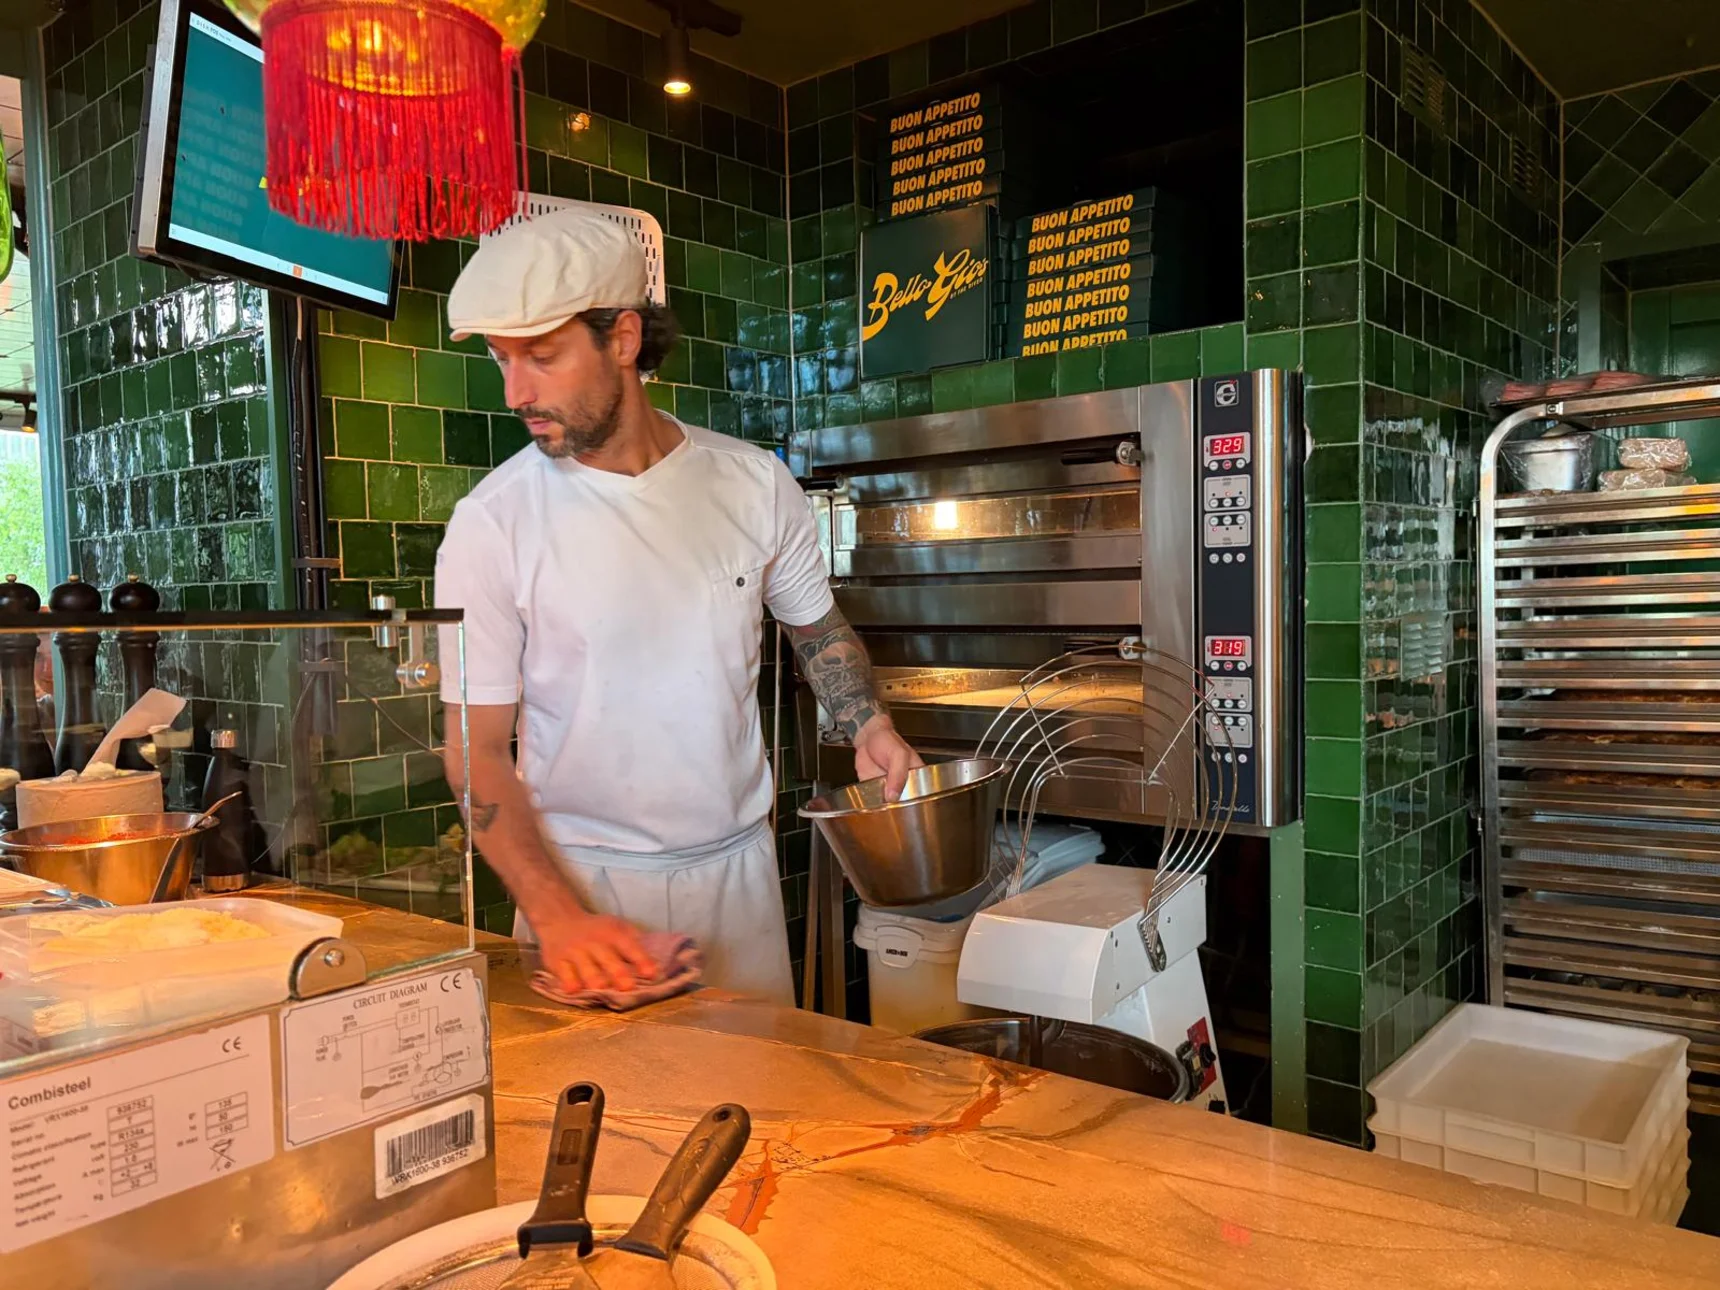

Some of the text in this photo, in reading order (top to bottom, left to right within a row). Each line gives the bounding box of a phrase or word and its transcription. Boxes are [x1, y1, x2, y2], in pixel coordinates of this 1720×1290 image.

[891, 92, 980, 133] BUON APPETITO
[892, 114, 983, 155] BUON APPETITO
[891, 137, 983, 176] BUON APPETITO
[893, 158, 985, 196] BUON APPETITO
[891, 180, 982, 216] BUON APPETITO
[1031, 194, 1133, 233] BUON APPETITO
[1028, 217, 1130, 254] BUON APPETITO
[1028, 239, 1130, 275] BUON APPETITO
[862, 248, 989, 341] Bello Gio's
[1027, 263, 1131, 298] BUON APPETITO
[1025, 284, 1130, 318] BUON APPETITO
[1023, 305, 1128, 339] BUON APPETITO
[1213, 437, 1244, 455] 329
[1213, 640, 1244, 656] 319
[353, 992, 387, 1010] CIRCUIT
[390, 982, 428, 1000] DIAGRAM
[8, 1076, 92, 1110] Combisteel
